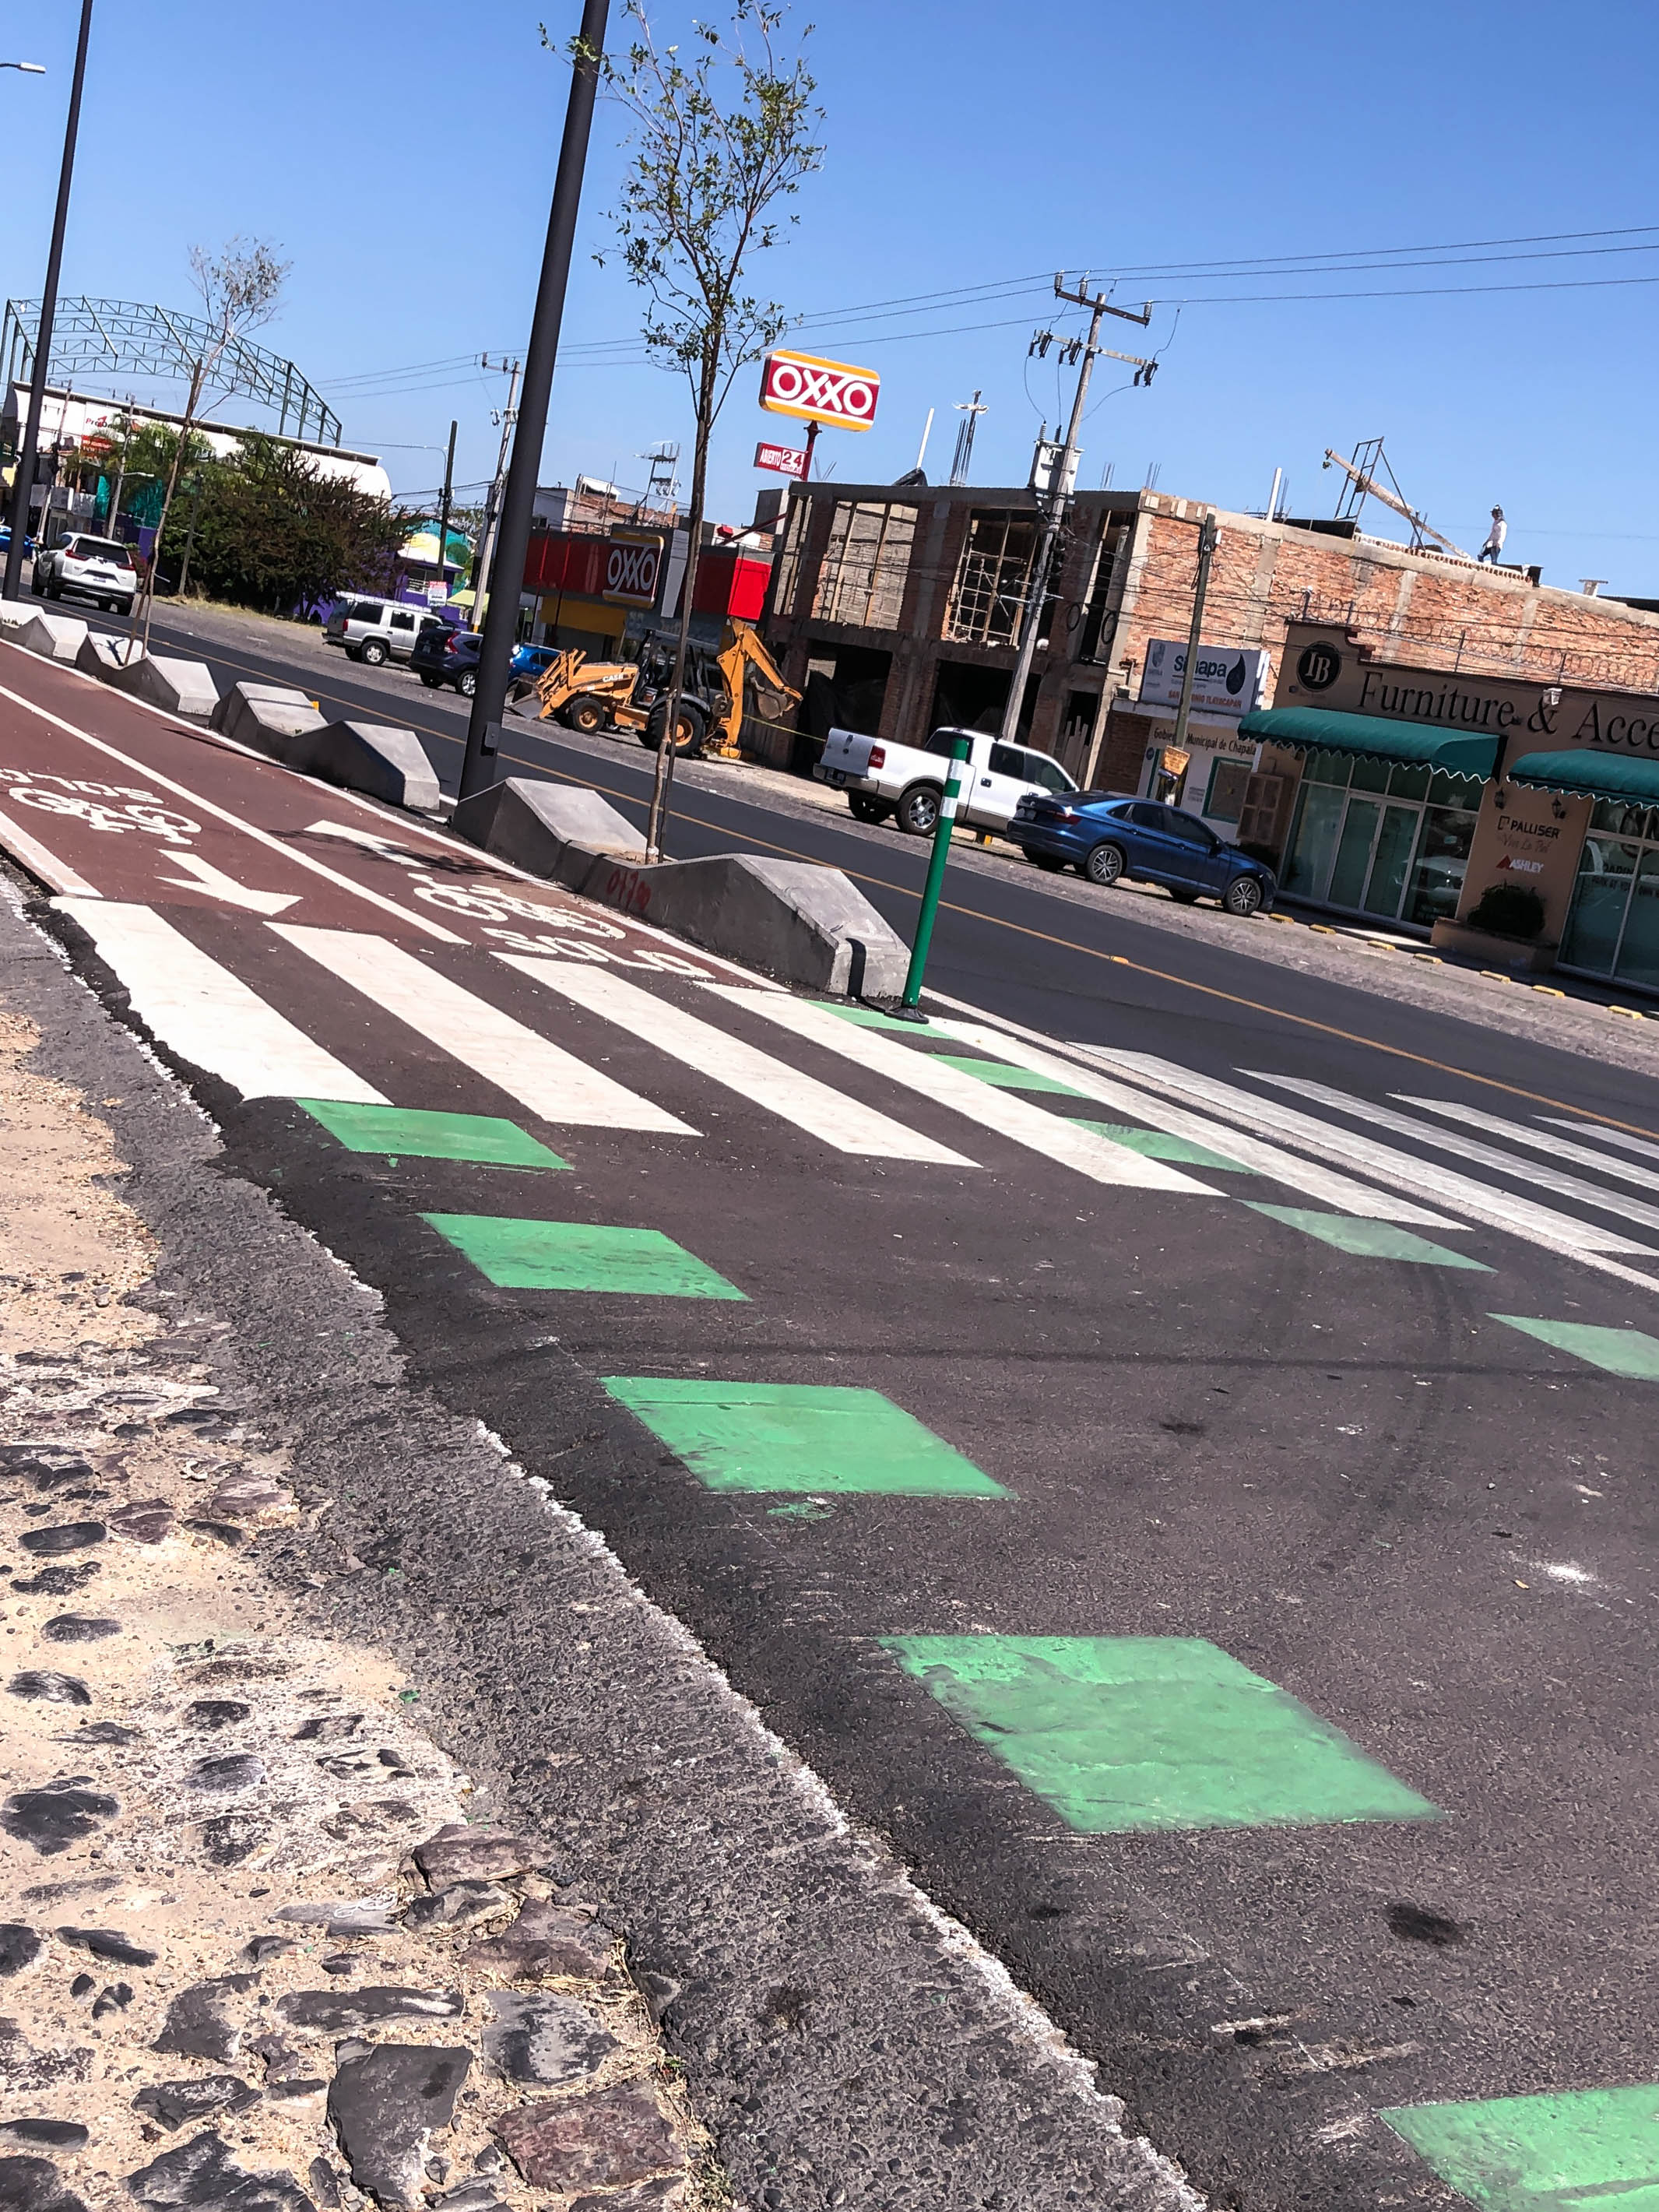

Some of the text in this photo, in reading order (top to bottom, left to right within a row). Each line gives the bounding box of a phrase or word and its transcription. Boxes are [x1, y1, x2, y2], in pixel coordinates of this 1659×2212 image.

[772, 364, 873, 416] OXXO
[759, 448, 803, 467] ABIERTO 24
[607, 548, 656, 592] OXXO
[603, 673, 624, 683] CASE
[1358, 670, 1515, 727] Furniture
[1527, 695, 1559, 734] &
[1185, 733, 1218, 751] Municipal
[1219, 737, 1227, 751] de
[1228, 740, 1257, 756] Chapala
[1510, 820, 1560, 839] PALLISER
[1510, 859, 1544, 873] ASHLEY
[480, 927, 717, 979] SOLO
